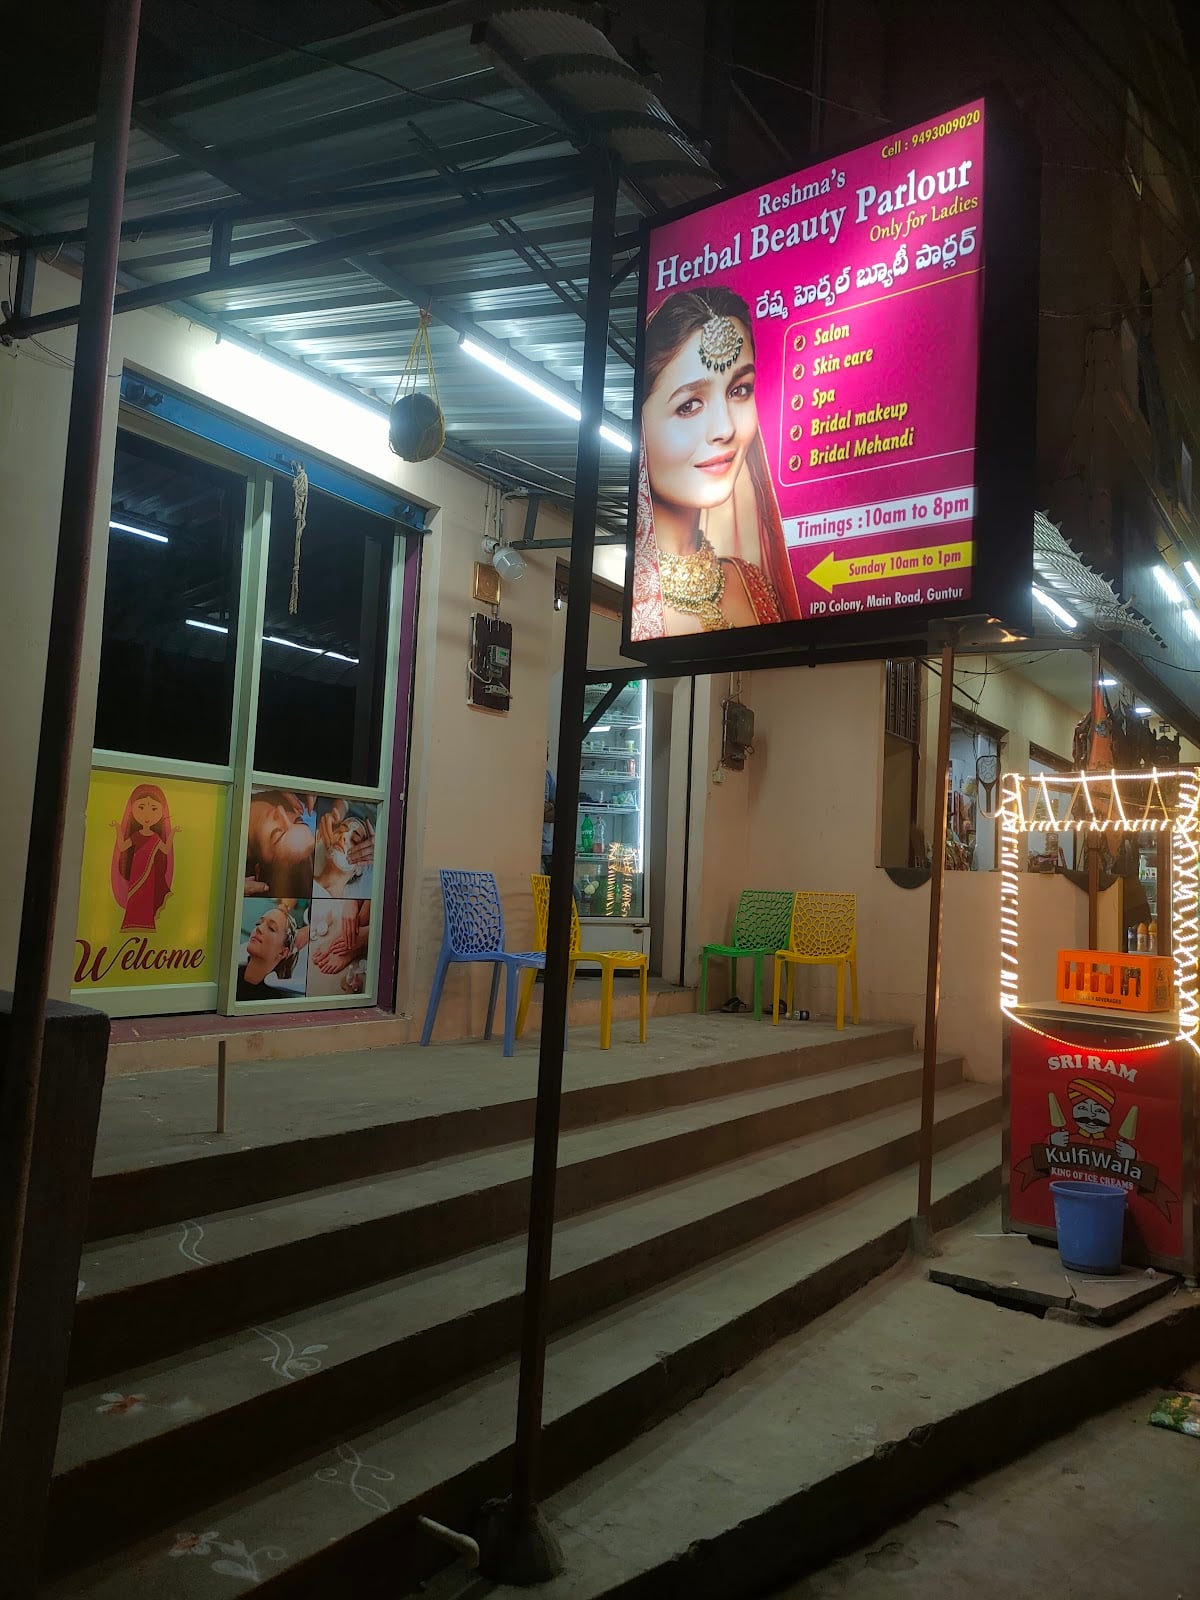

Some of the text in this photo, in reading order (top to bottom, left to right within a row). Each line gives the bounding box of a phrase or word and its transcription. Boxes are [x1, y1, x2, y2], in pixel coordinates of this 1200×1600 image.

[881, 139, 901, 158] Cell
[911, 109, 980, 147] 9493009020
[757, 167, 846, 218] Reshma's
[655, 158, 973, 292] Herbal Beauty Parlour
[869, 195, 978, 242] Only for Ladies
[756, 226, 977, 319] రేష్మ హెర్బల్ బ్యూటీ పార్లర్
[813, 322, 850, 347] Salon
[813, 348, 873, 377] Skin care
[811, 387, 835, 409] Spa
[810, 401, 908, 437] Bridal makeup
[809, 427, 915, 467] Bridal Mehandi
[797, 518, 852, 539] Timings
[912, 503, 927, 519] to
[933, 497, 969, 519] 8pm
[849, 550, 961, 577] Sunday 10am to 1pm
[810, 587, 963, 615] IPD Colony, Main Road, Guntur
[74, 936, 206, 983] Welcome
[1048, 1054, 1138, 1083] SRI RAM
[1045, 1147, 1142, 1180] KulfiWala
[1051, 1166, 1134, 1191] KING OF ICE CREAMS
